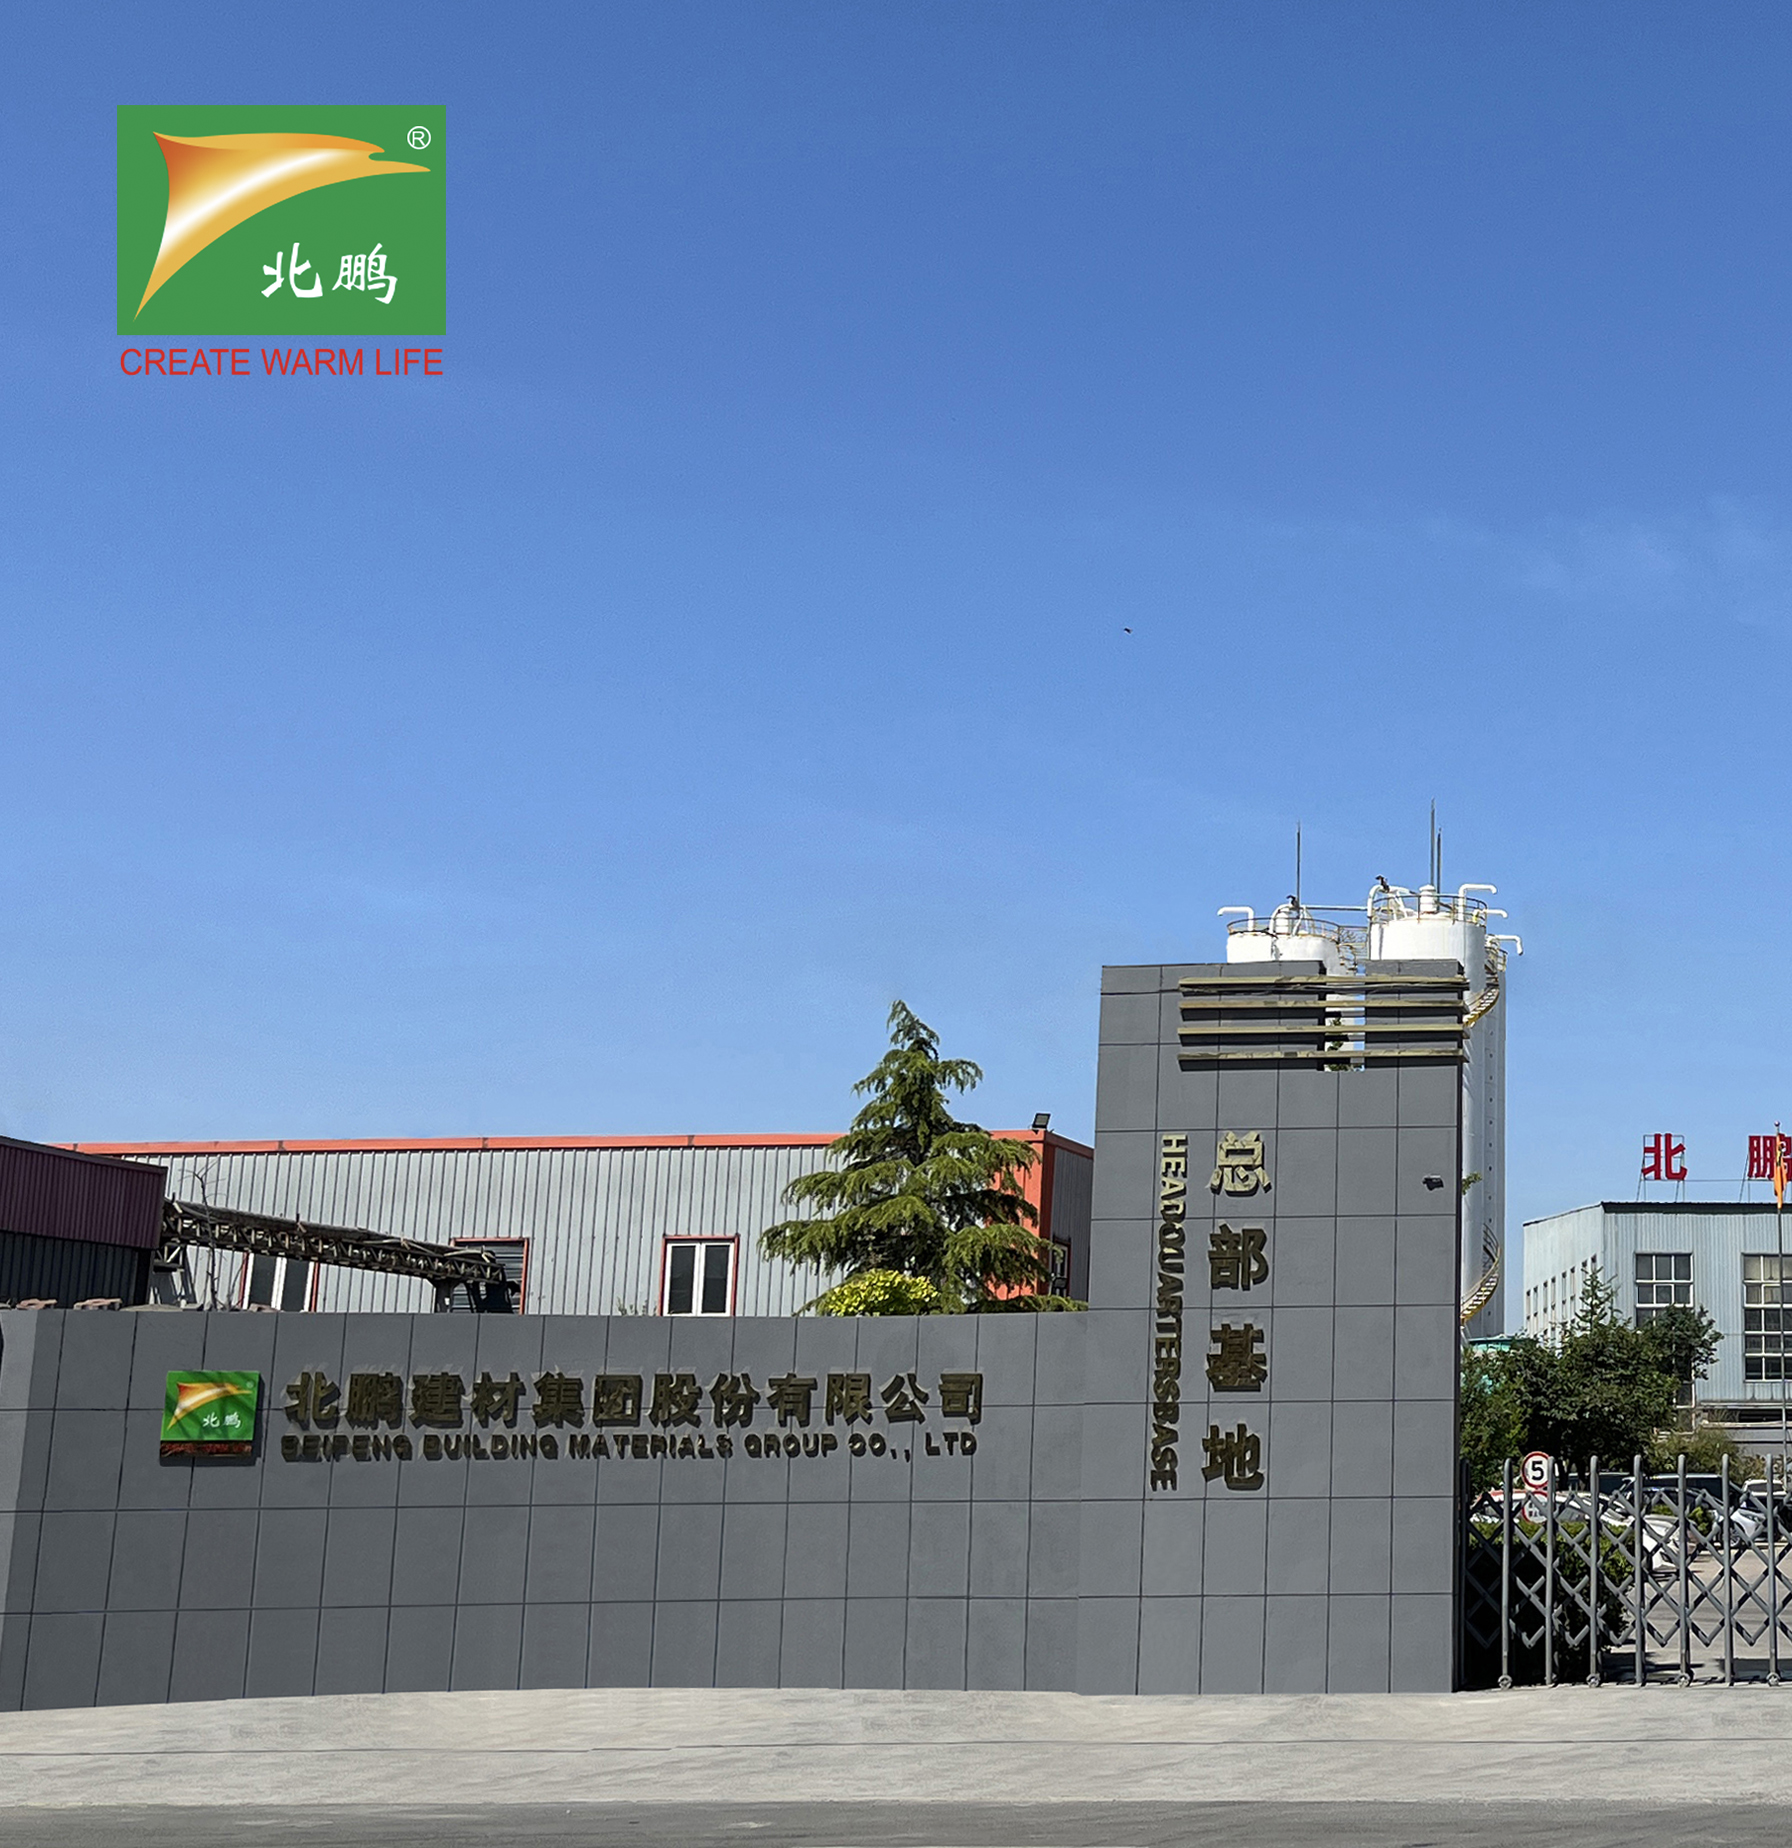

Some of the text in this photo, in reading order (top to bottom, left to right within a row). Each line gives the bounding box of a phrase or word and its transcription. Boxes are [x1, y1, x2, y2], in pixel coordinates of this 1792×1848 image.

[1202, 1131, 1271, 1490] 总部基地
[284, 1372, 983, 1429] 北鹏建材集团股份有限公司
[281, 1434, 413, 1462] BEIPENG
[423, 1434, 559, 1461] BUILDING
[568, 1433, 733, 1460] MATERIALS
[744, 1433, 838, 1458] GROUP
[925, 1432, 977, 1456] LTD
[1531, 1460, 1544, 1480] 5
